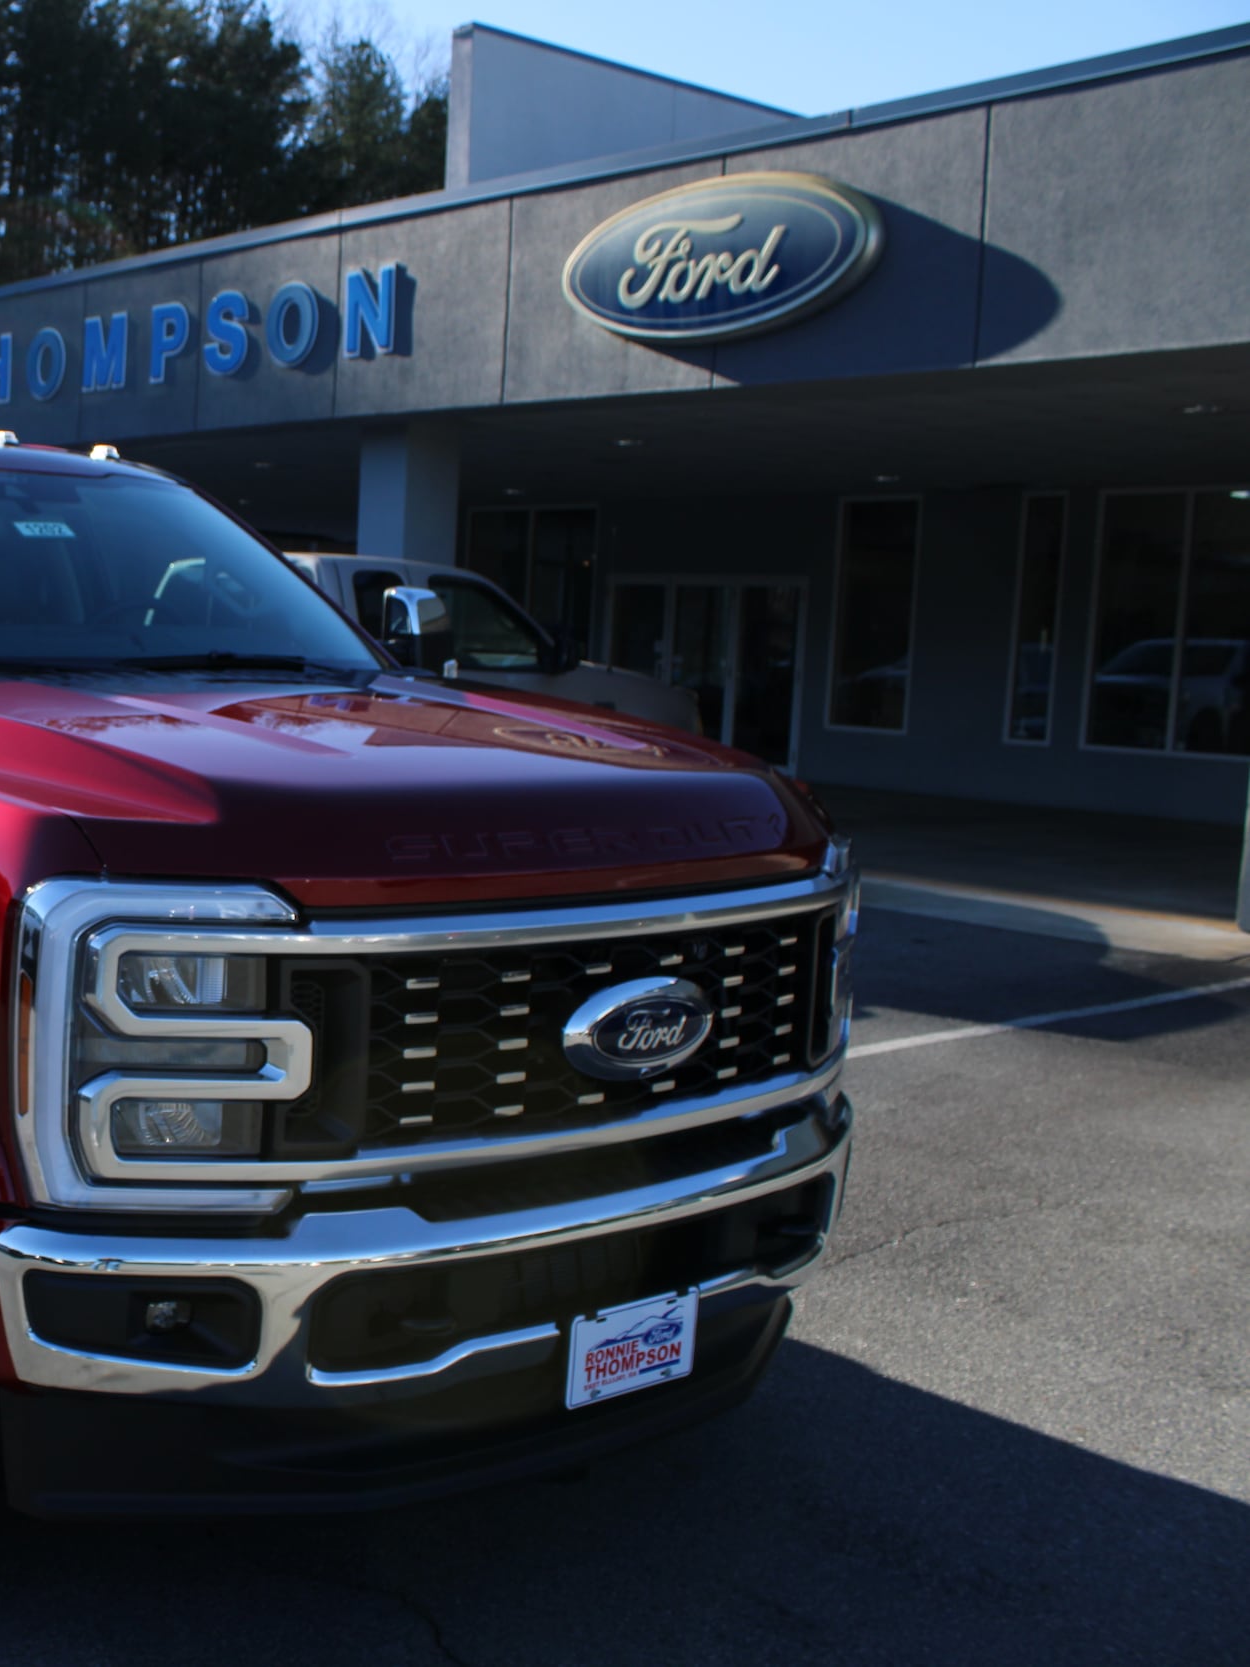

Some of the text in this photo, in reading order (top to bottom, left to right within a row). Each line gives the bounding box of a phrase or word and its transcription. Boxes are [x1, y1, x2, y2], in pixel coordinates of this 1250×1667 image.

[617, 212, 787, 310] Ford
[384, 826, 640, 864] SUPER
[617, 1009, 686, 1051] Ford
[586, 1340, 639, 1366] RONNIE
[651, 1325, 677, 1344] Ford
[585, 1342, 682, 1382] THOMPSON
